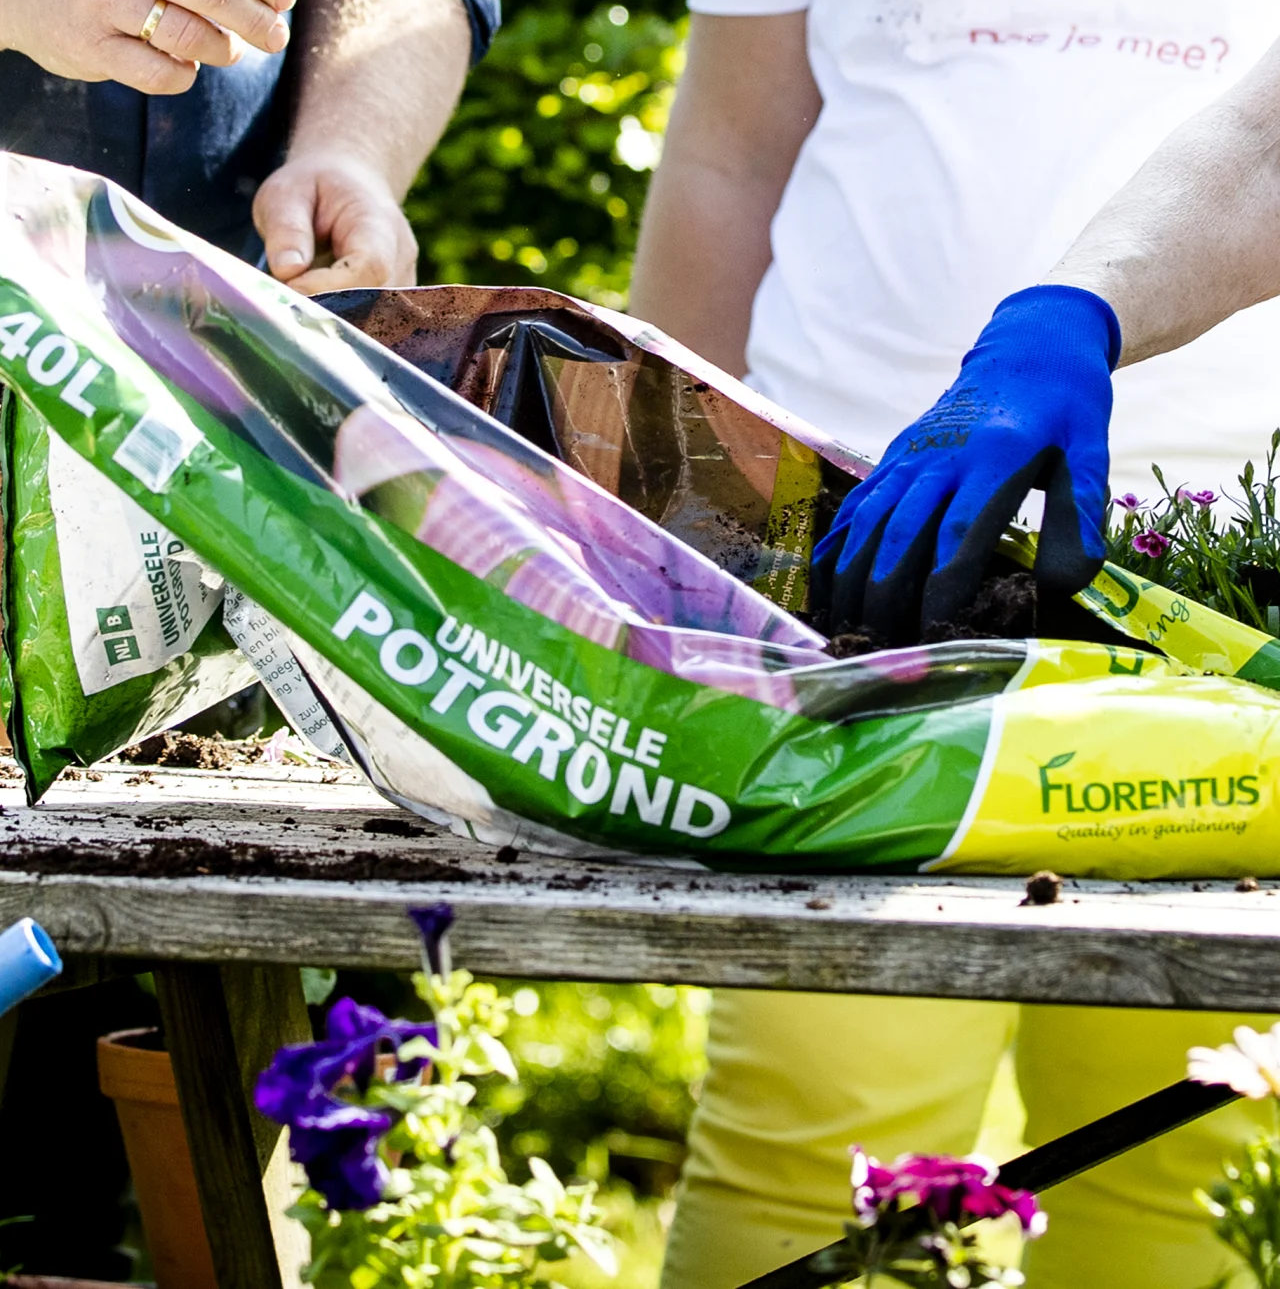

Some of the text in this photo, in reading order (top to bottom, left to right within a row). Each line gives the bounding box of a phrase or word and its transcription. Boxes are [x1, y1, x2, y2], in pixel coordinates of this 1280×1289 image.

[106, 614, 123, 627] B
[140, 531, 180, 648] UNIVERSELE
[166, 540, 192, 633] POTGROD
[113, 638, 132, 661] NL
[331, 590, 732, 839] POTGROND
[435, 615, 668, 769] UNIVERSELE
[1038, 752, 1260, 814] FLORENTUS
[1056, 818, 1248, 841] Quality in gardening
